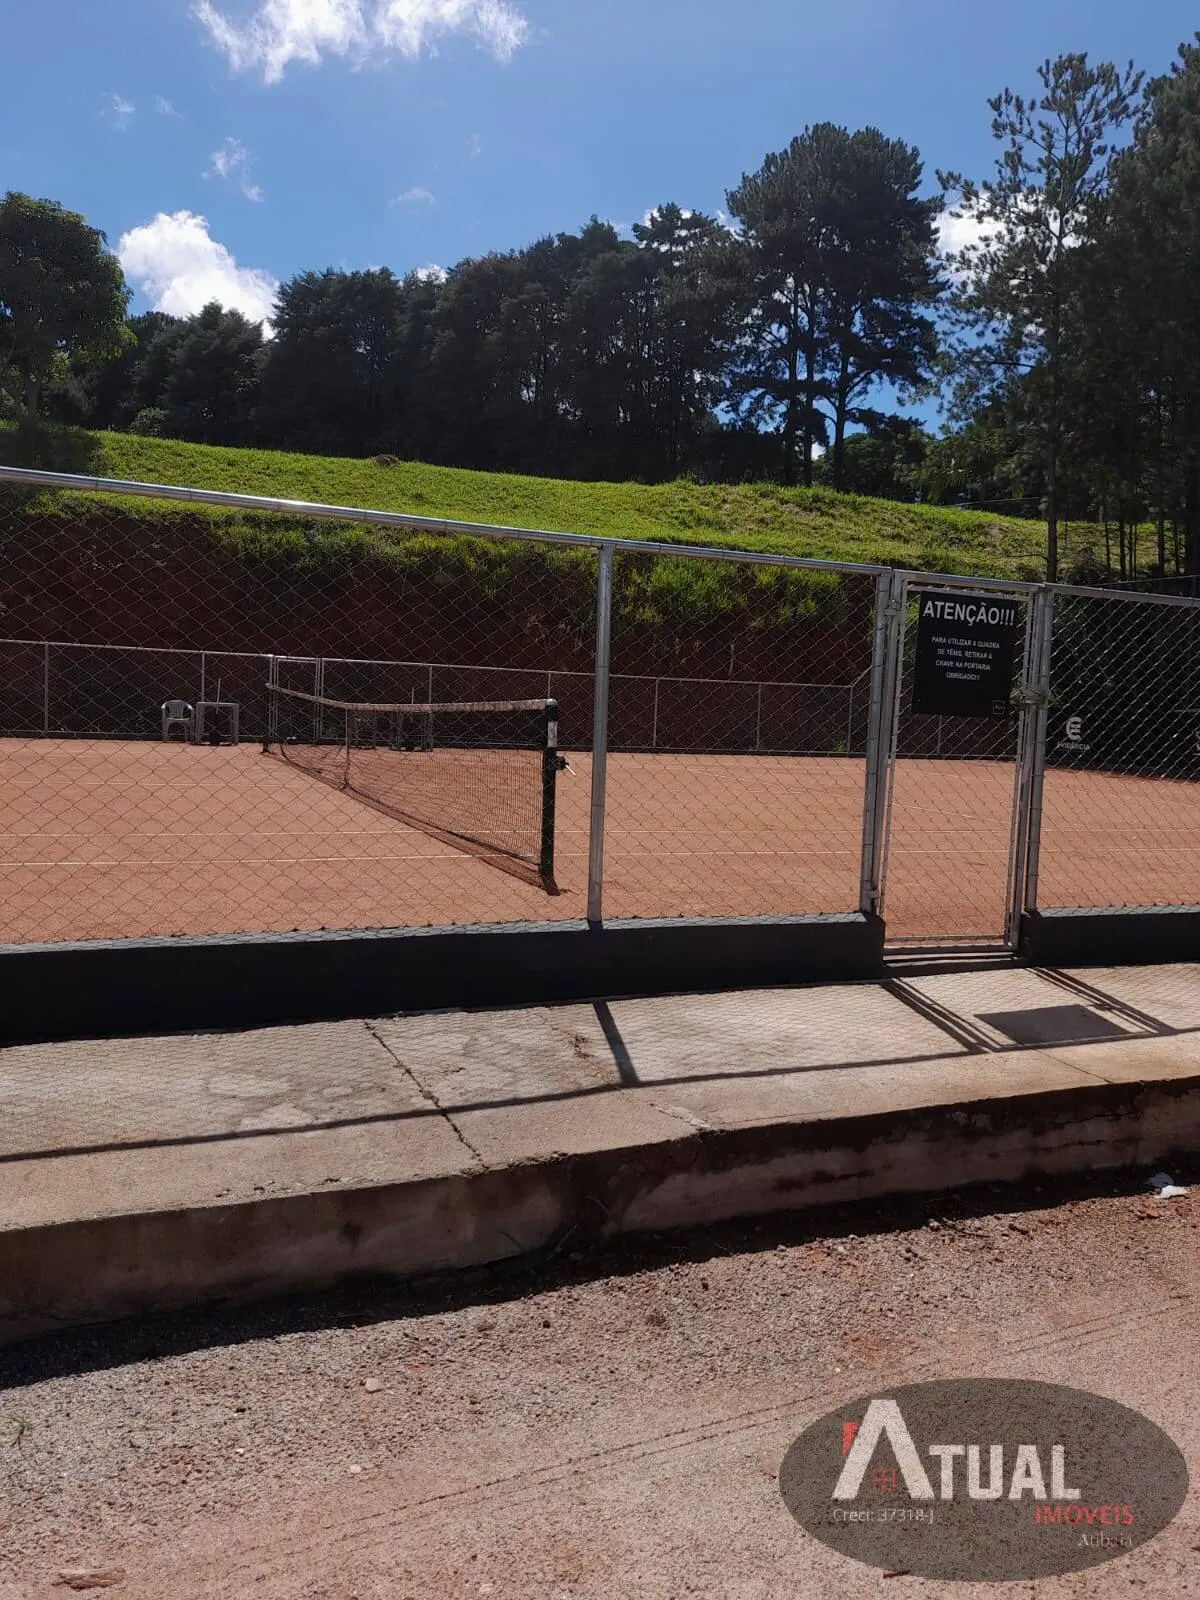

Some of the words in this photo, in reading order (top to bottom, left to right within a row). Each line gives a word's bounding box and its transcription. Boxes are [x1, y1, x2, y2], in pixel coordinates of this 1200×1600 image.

[922, 600, 1015, 626] ATENÇÃO!!!
[947, 637, 972, 646] UTILIZAR
[977, 640, 1000, 649] QUADRA
[935, 659, 955, 667] CHAVE
